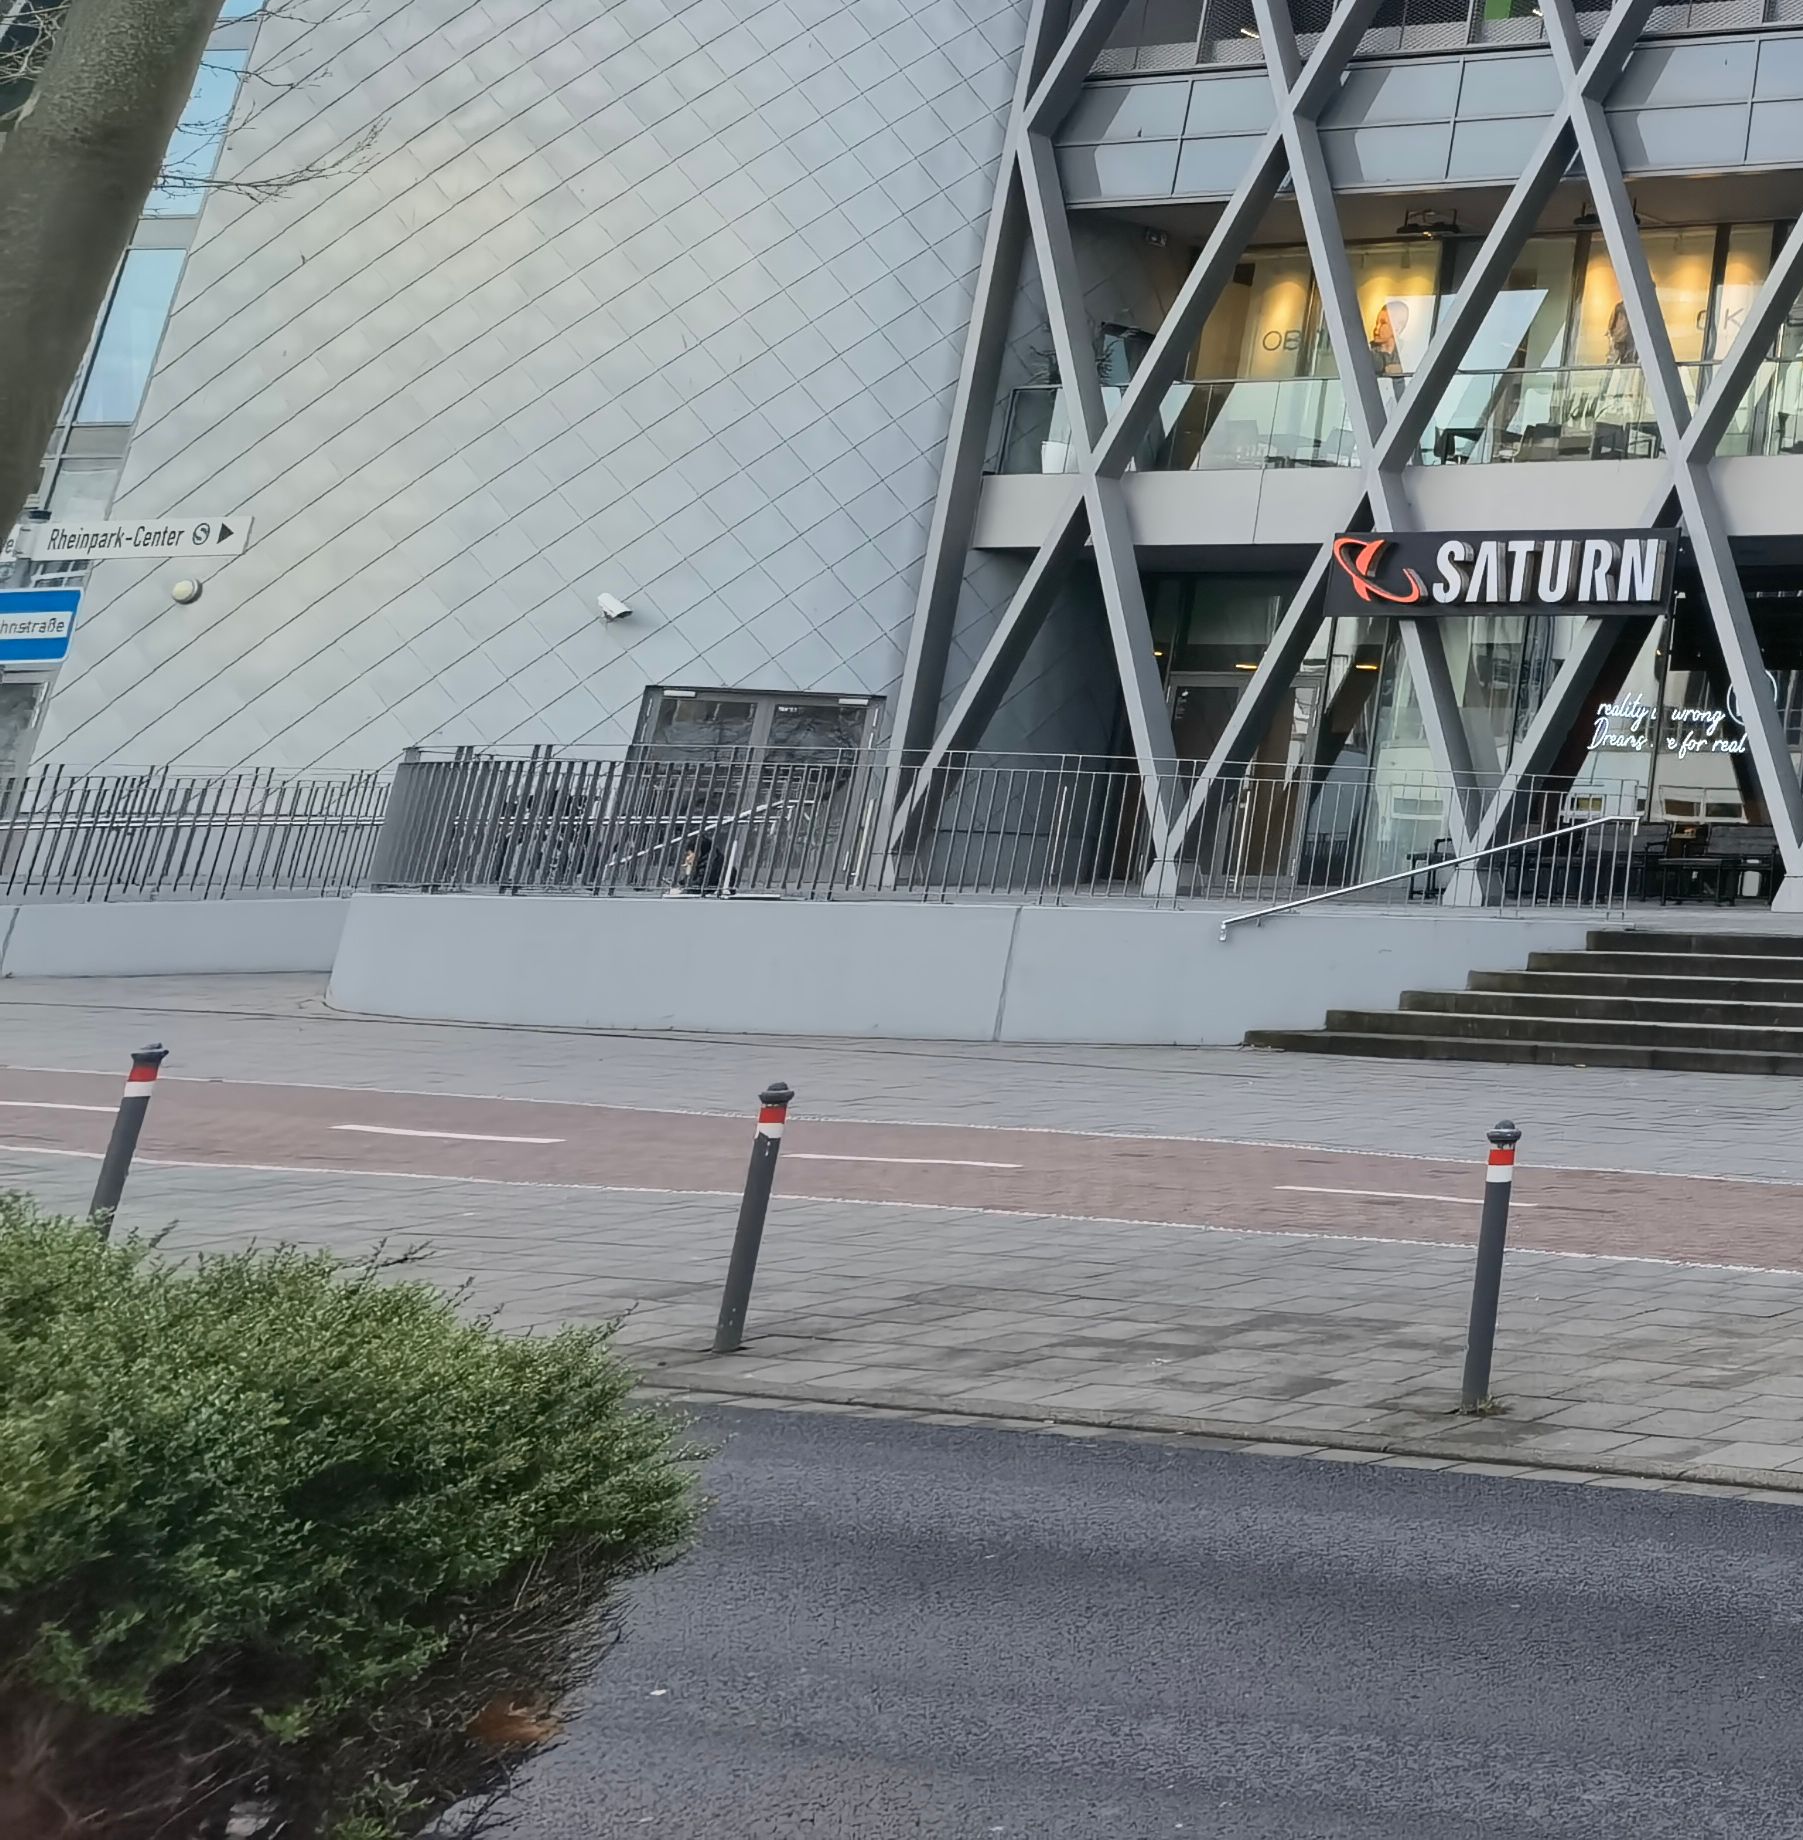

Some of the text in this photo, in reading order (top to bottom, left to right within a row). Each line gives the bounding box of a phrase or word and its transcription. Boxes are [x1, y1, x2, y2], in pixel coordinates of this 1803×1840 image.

[46, 525, 185, 555] Rheinpark-Center
[1432, 538, 1661, 604] SATURN
[1597, 692, 1648, 732] reality
[1671, 709, 1725, 737] wrong
[1678, 730, 1708, 759] for
[1711, 732, 1748, 754] real
